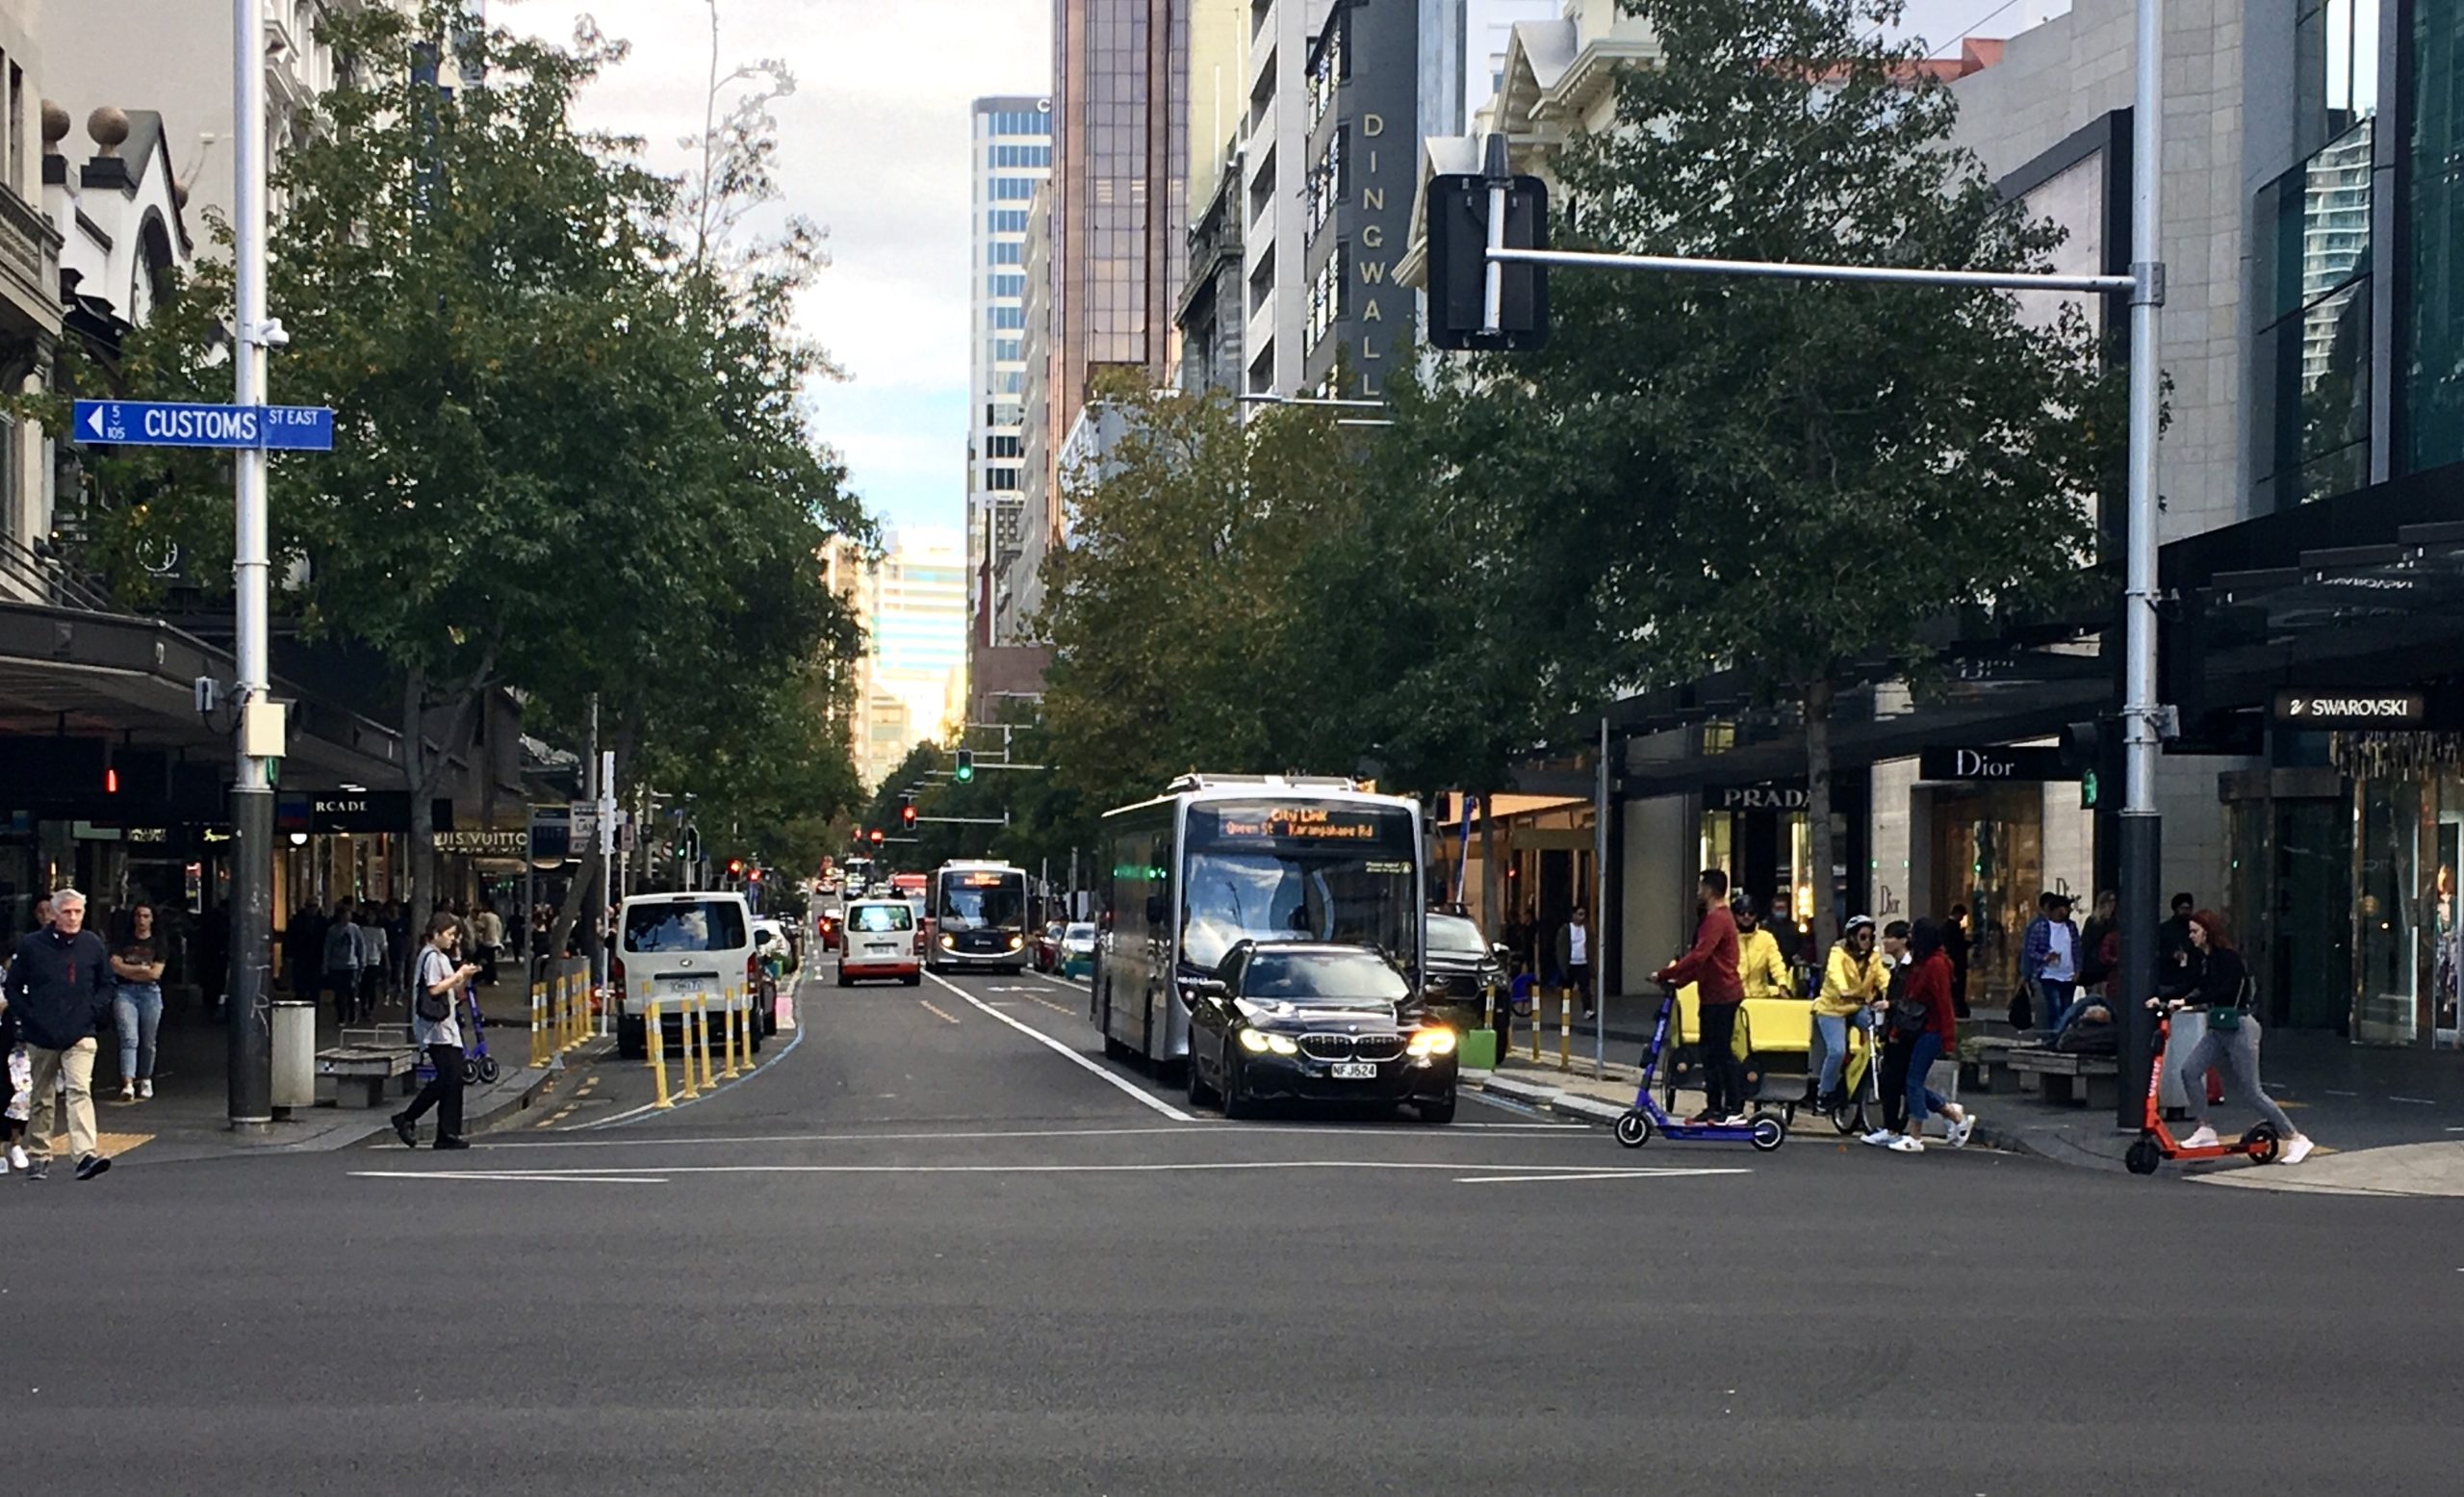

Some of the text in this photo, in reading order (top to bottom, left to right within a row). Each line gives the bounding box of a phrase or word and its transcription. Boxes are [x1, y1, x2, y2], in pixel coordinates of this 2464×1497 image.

[1359, 113, 1386, 397] DINGWALL
[112, 404, 120, 418] 5
[107, 426, 126, 440] 105
[144, 409, 319, 440] CUSTOMS ST EAST
[2311, 699, 2408, 716] SWAROVSKI
[1956, 749, 2015, 777] Dior
[1333, 1065, 1375, 1076] NFJ624
